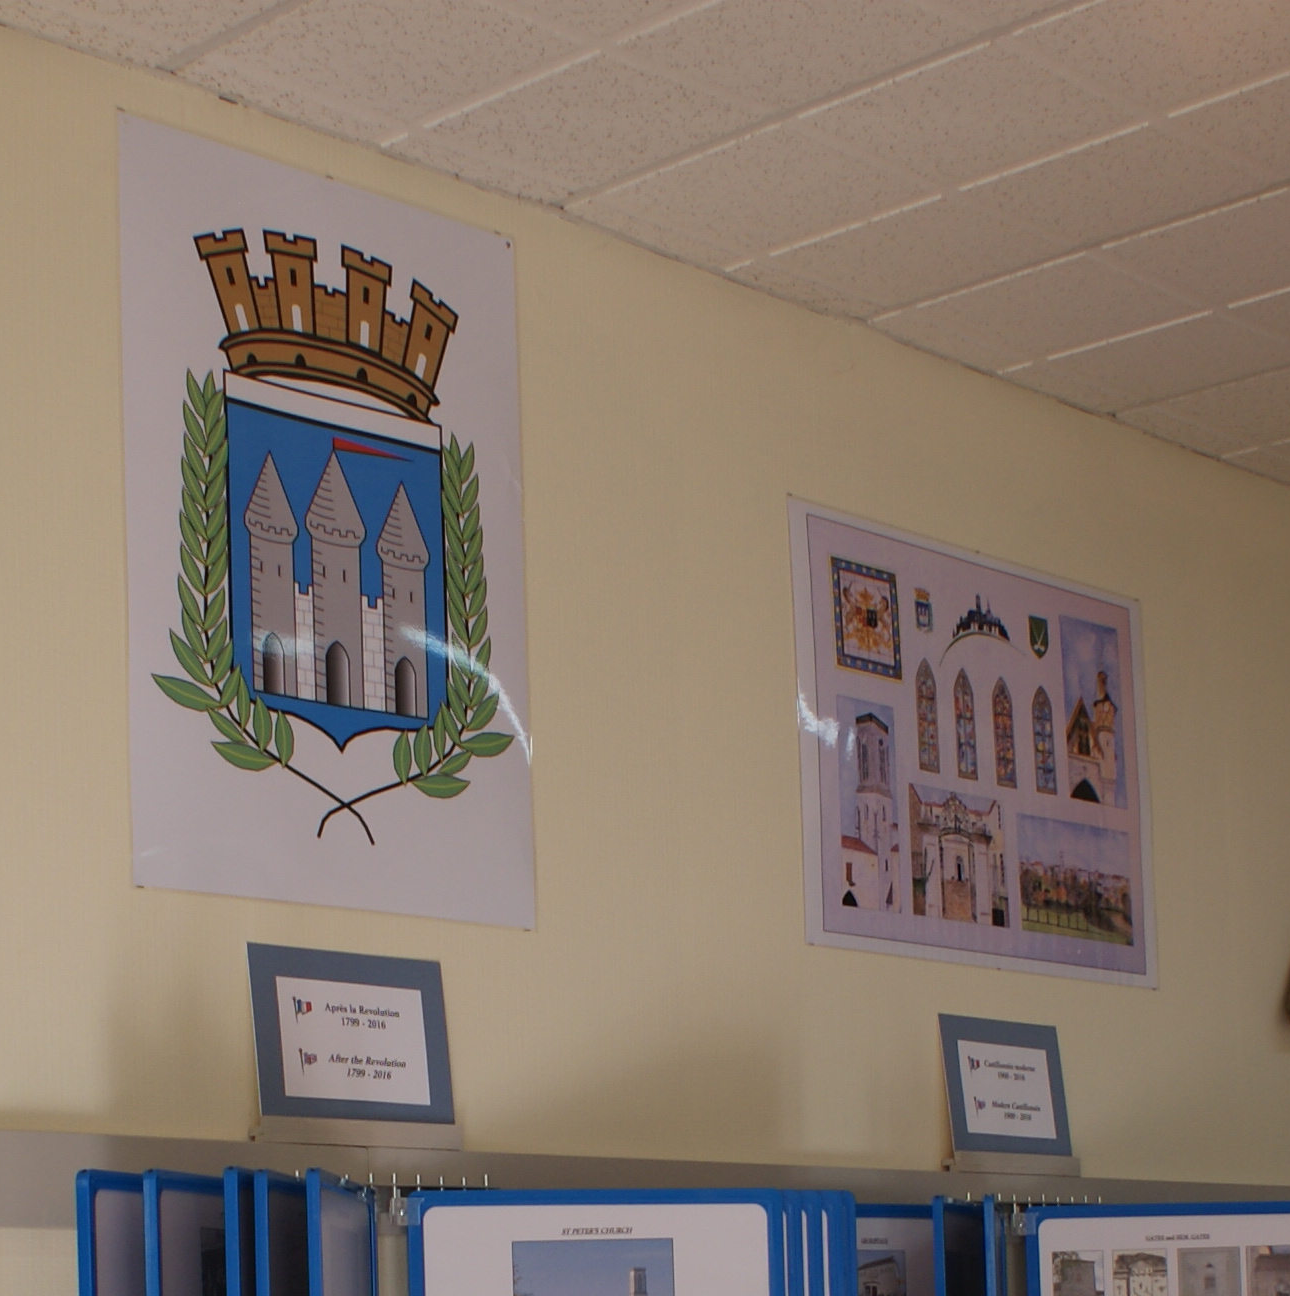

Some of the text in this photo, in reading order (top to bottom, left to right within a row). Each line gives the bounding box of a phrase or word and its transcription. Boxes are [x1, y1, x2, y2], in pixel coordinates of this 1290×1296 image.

[325, 1002, 347, 1015] Après
[350, 1004, 356, 1014] la
[341, 1017, 360, 1028] 1799
[367, 1020, 386, 1030] 2016
[328, 1053, 407, 1069] After the Revolution
[347, 1068, 366, 1079] 1799
[373, 1070, 392, 1081] 2016
